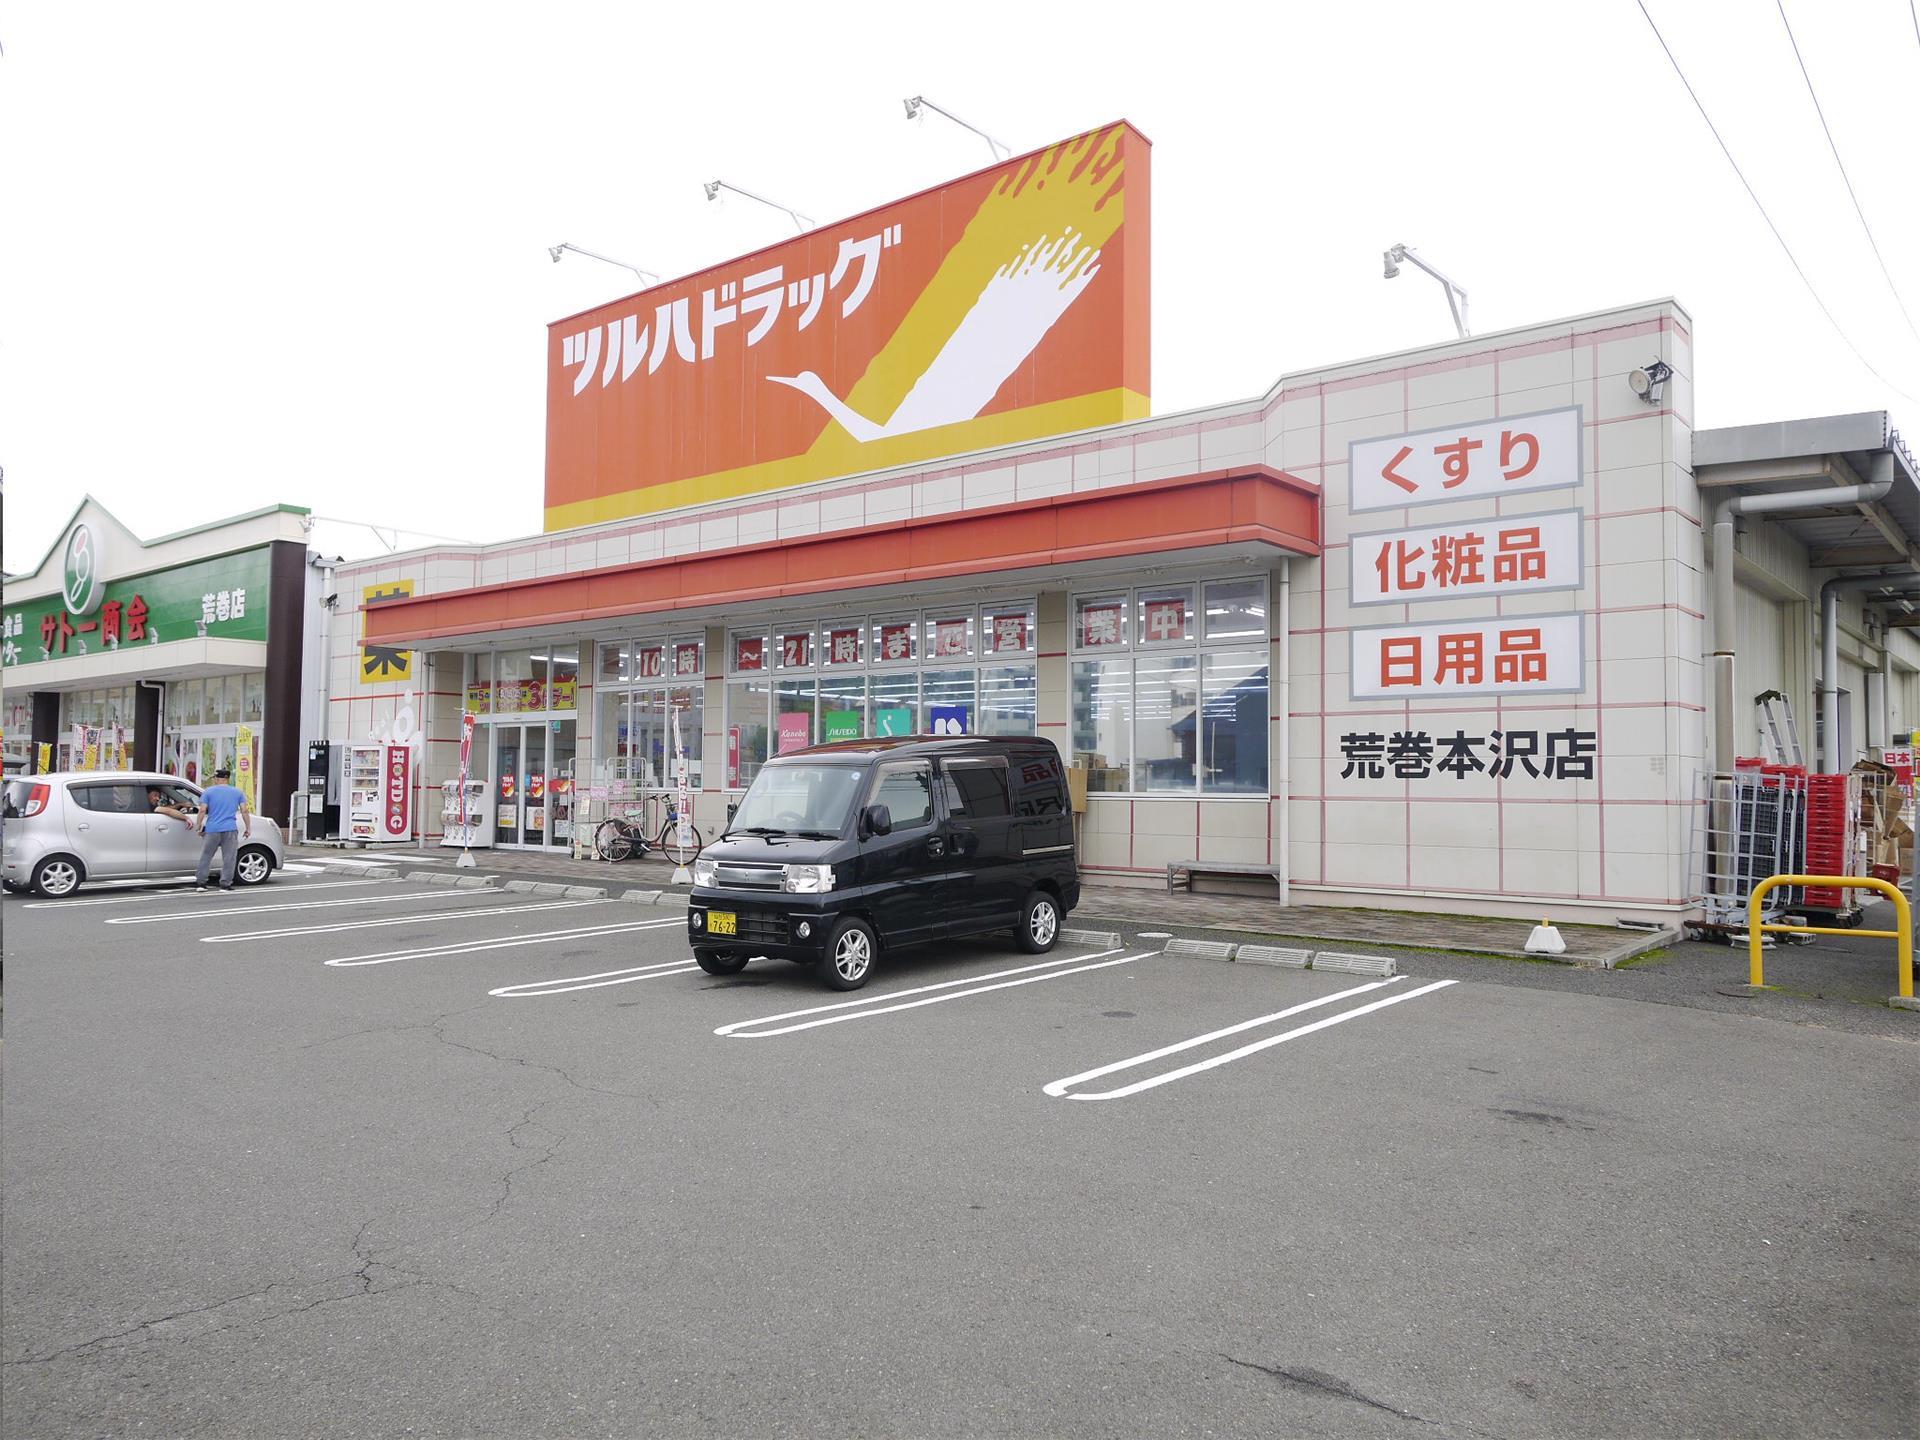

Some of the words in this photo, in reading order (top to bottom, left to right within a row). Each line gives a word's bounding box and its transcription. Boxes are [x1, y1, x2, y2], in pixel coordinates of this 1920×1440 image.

[563, 224, 901, 396] ツルハドラッグ
[1381, 430, 1540, 493] くすり
[1375, 527, 1546, 592] 化粧品
[41, 593, 148, 653] サトー商会
[202, 588, 246, 624] 荒巻店
[1381, 628, 1547, 687] 日用品
[1340, 728, 1596, 780] 荒巻本沢店
[1884, 752, 1911, 765] 日本
[713, 920, 736, 933] 76-22
